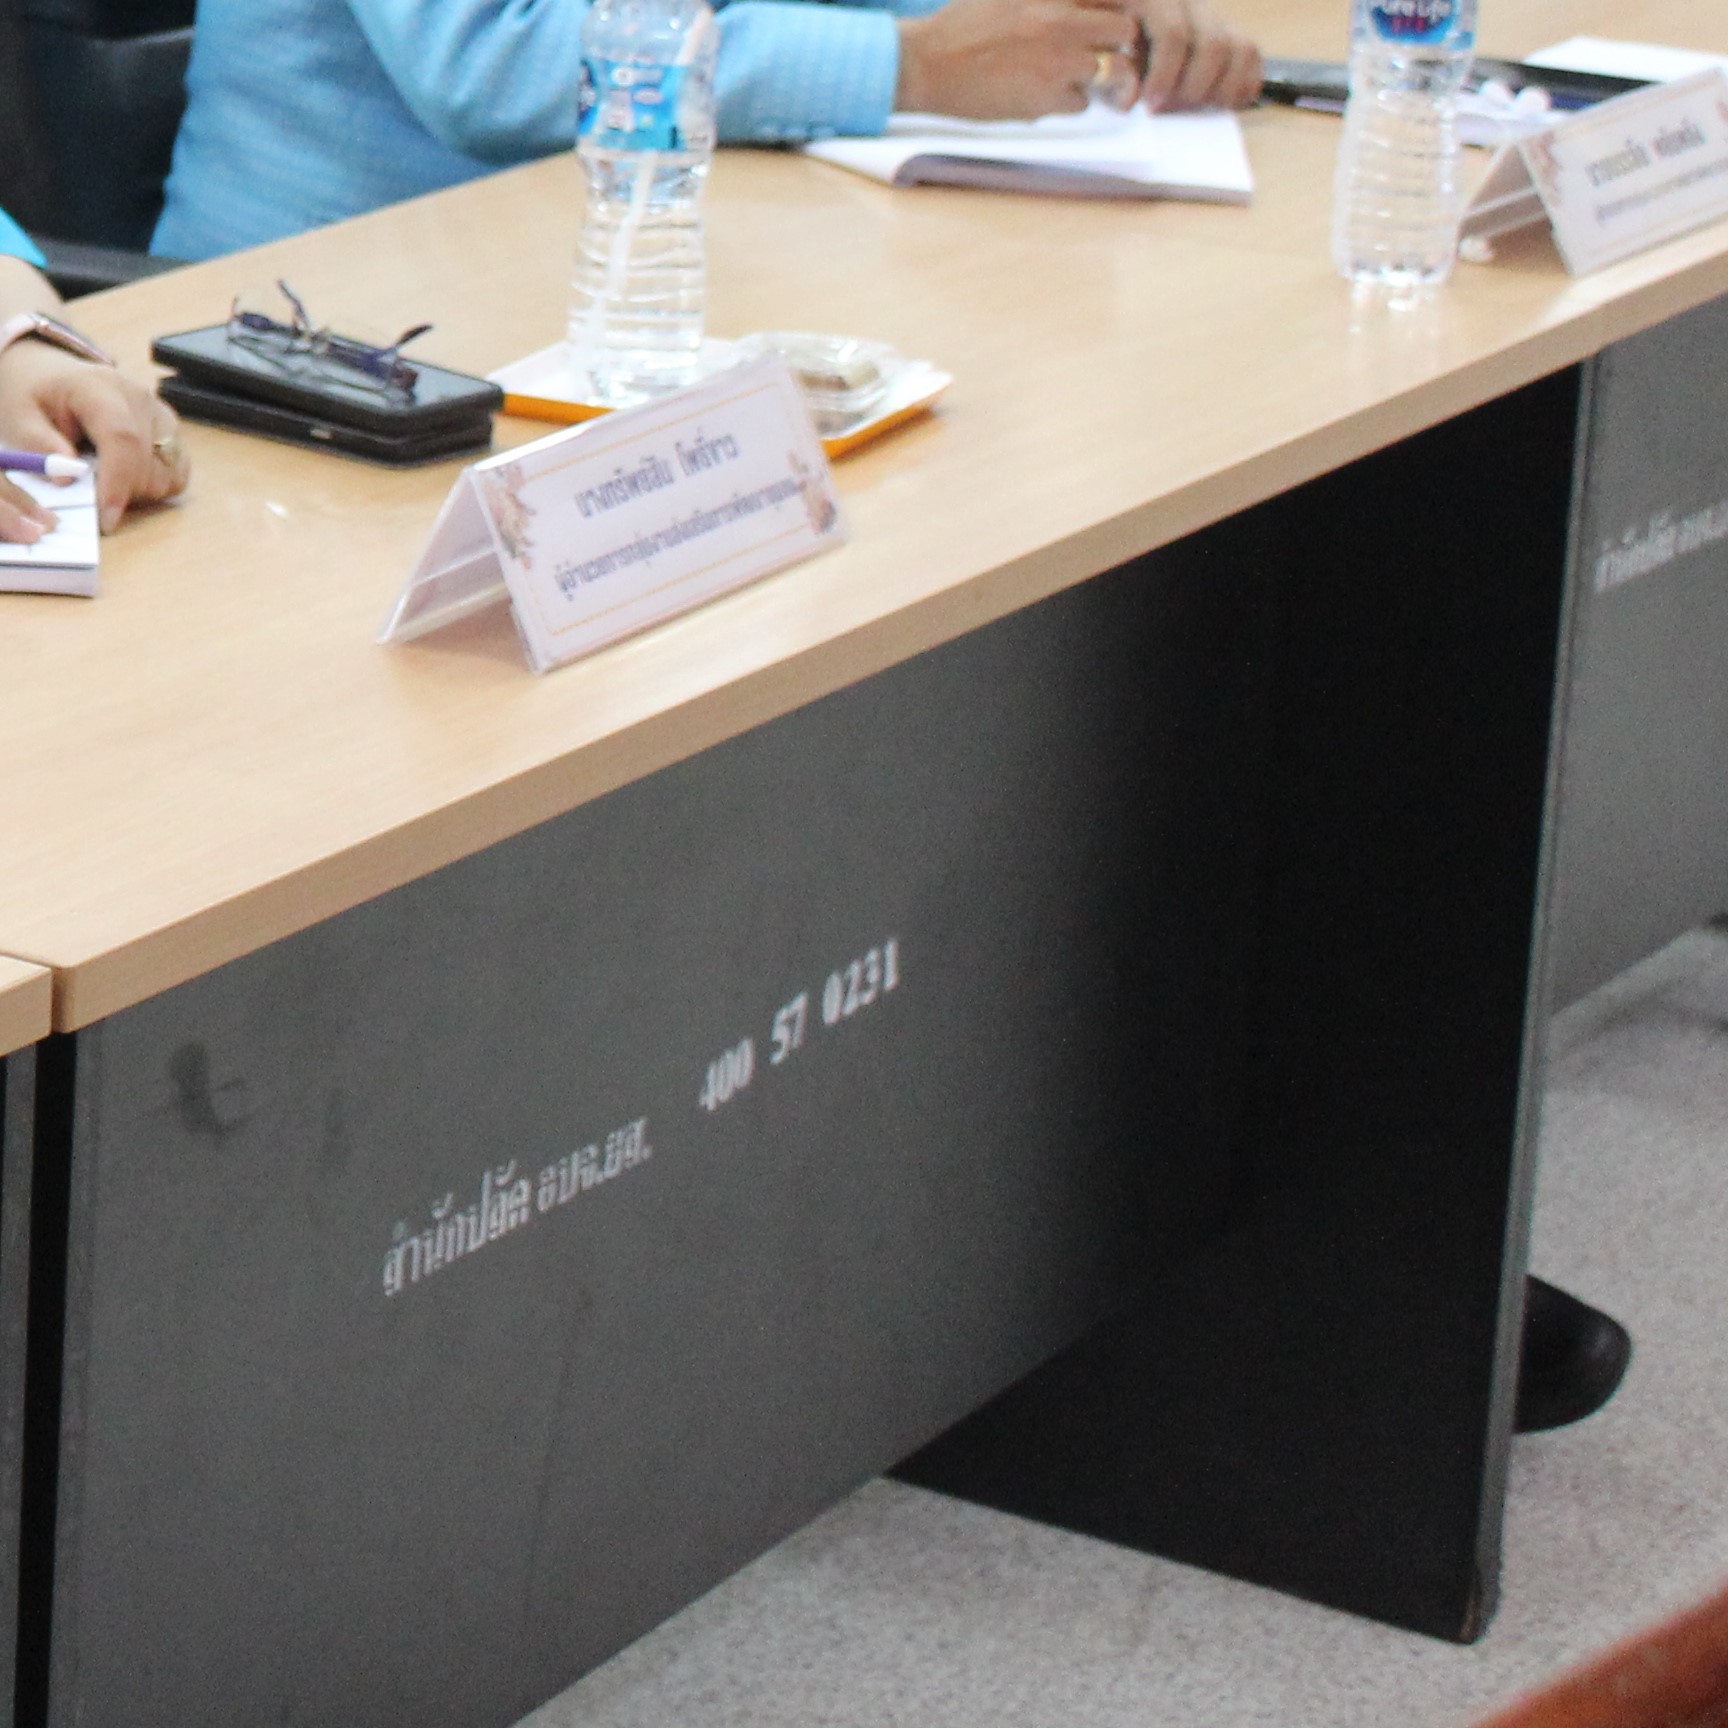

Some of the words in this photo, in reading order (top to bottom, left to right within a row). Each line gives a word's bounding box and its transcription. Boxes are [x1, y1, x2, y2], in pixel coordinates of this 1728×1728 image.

[699, 1037, 755, 1111] 400
[770, 991, 808, 1064] 57
[822, 936, 900, 1026] 0231
